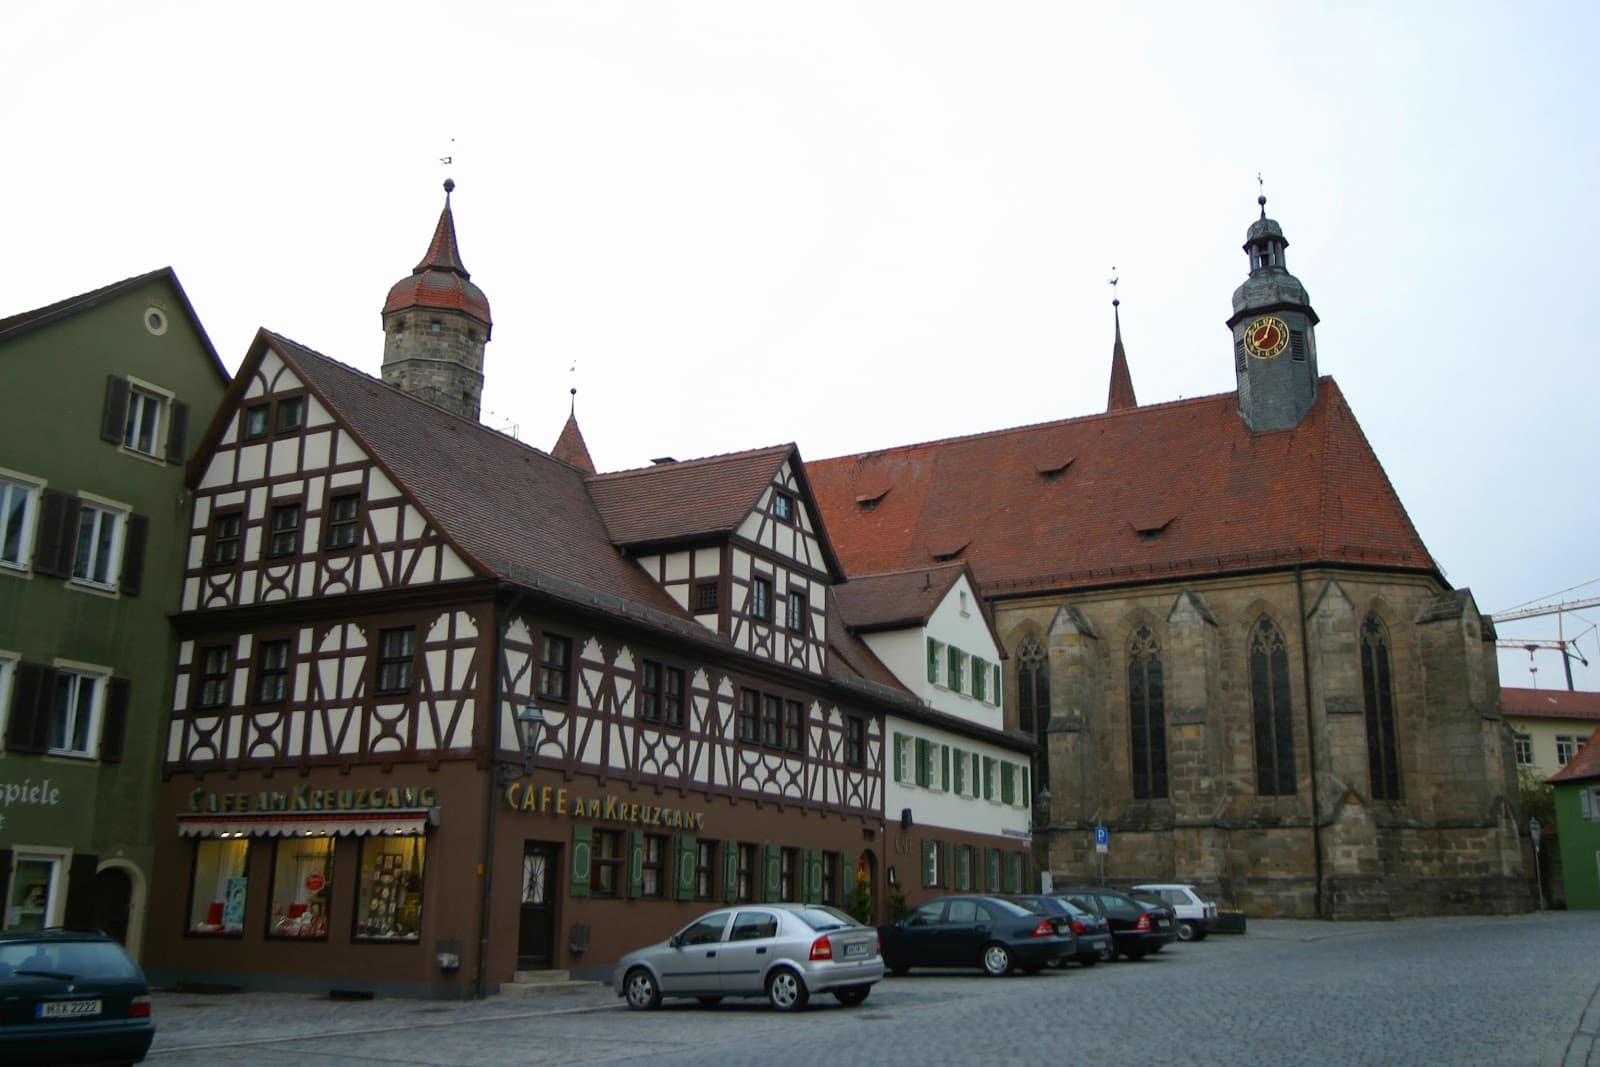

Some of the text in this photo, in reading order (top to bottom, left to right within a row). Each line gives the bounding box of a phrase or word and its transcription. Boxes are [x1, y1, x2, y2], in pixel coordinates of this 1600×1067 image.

[190, 787, 249, 813] CAFE
[257, 790, 288, 811] AM
[507, 783, 705, 830] CAFE AM KREUZGANG
[1098, 829, 1105, 841] P
